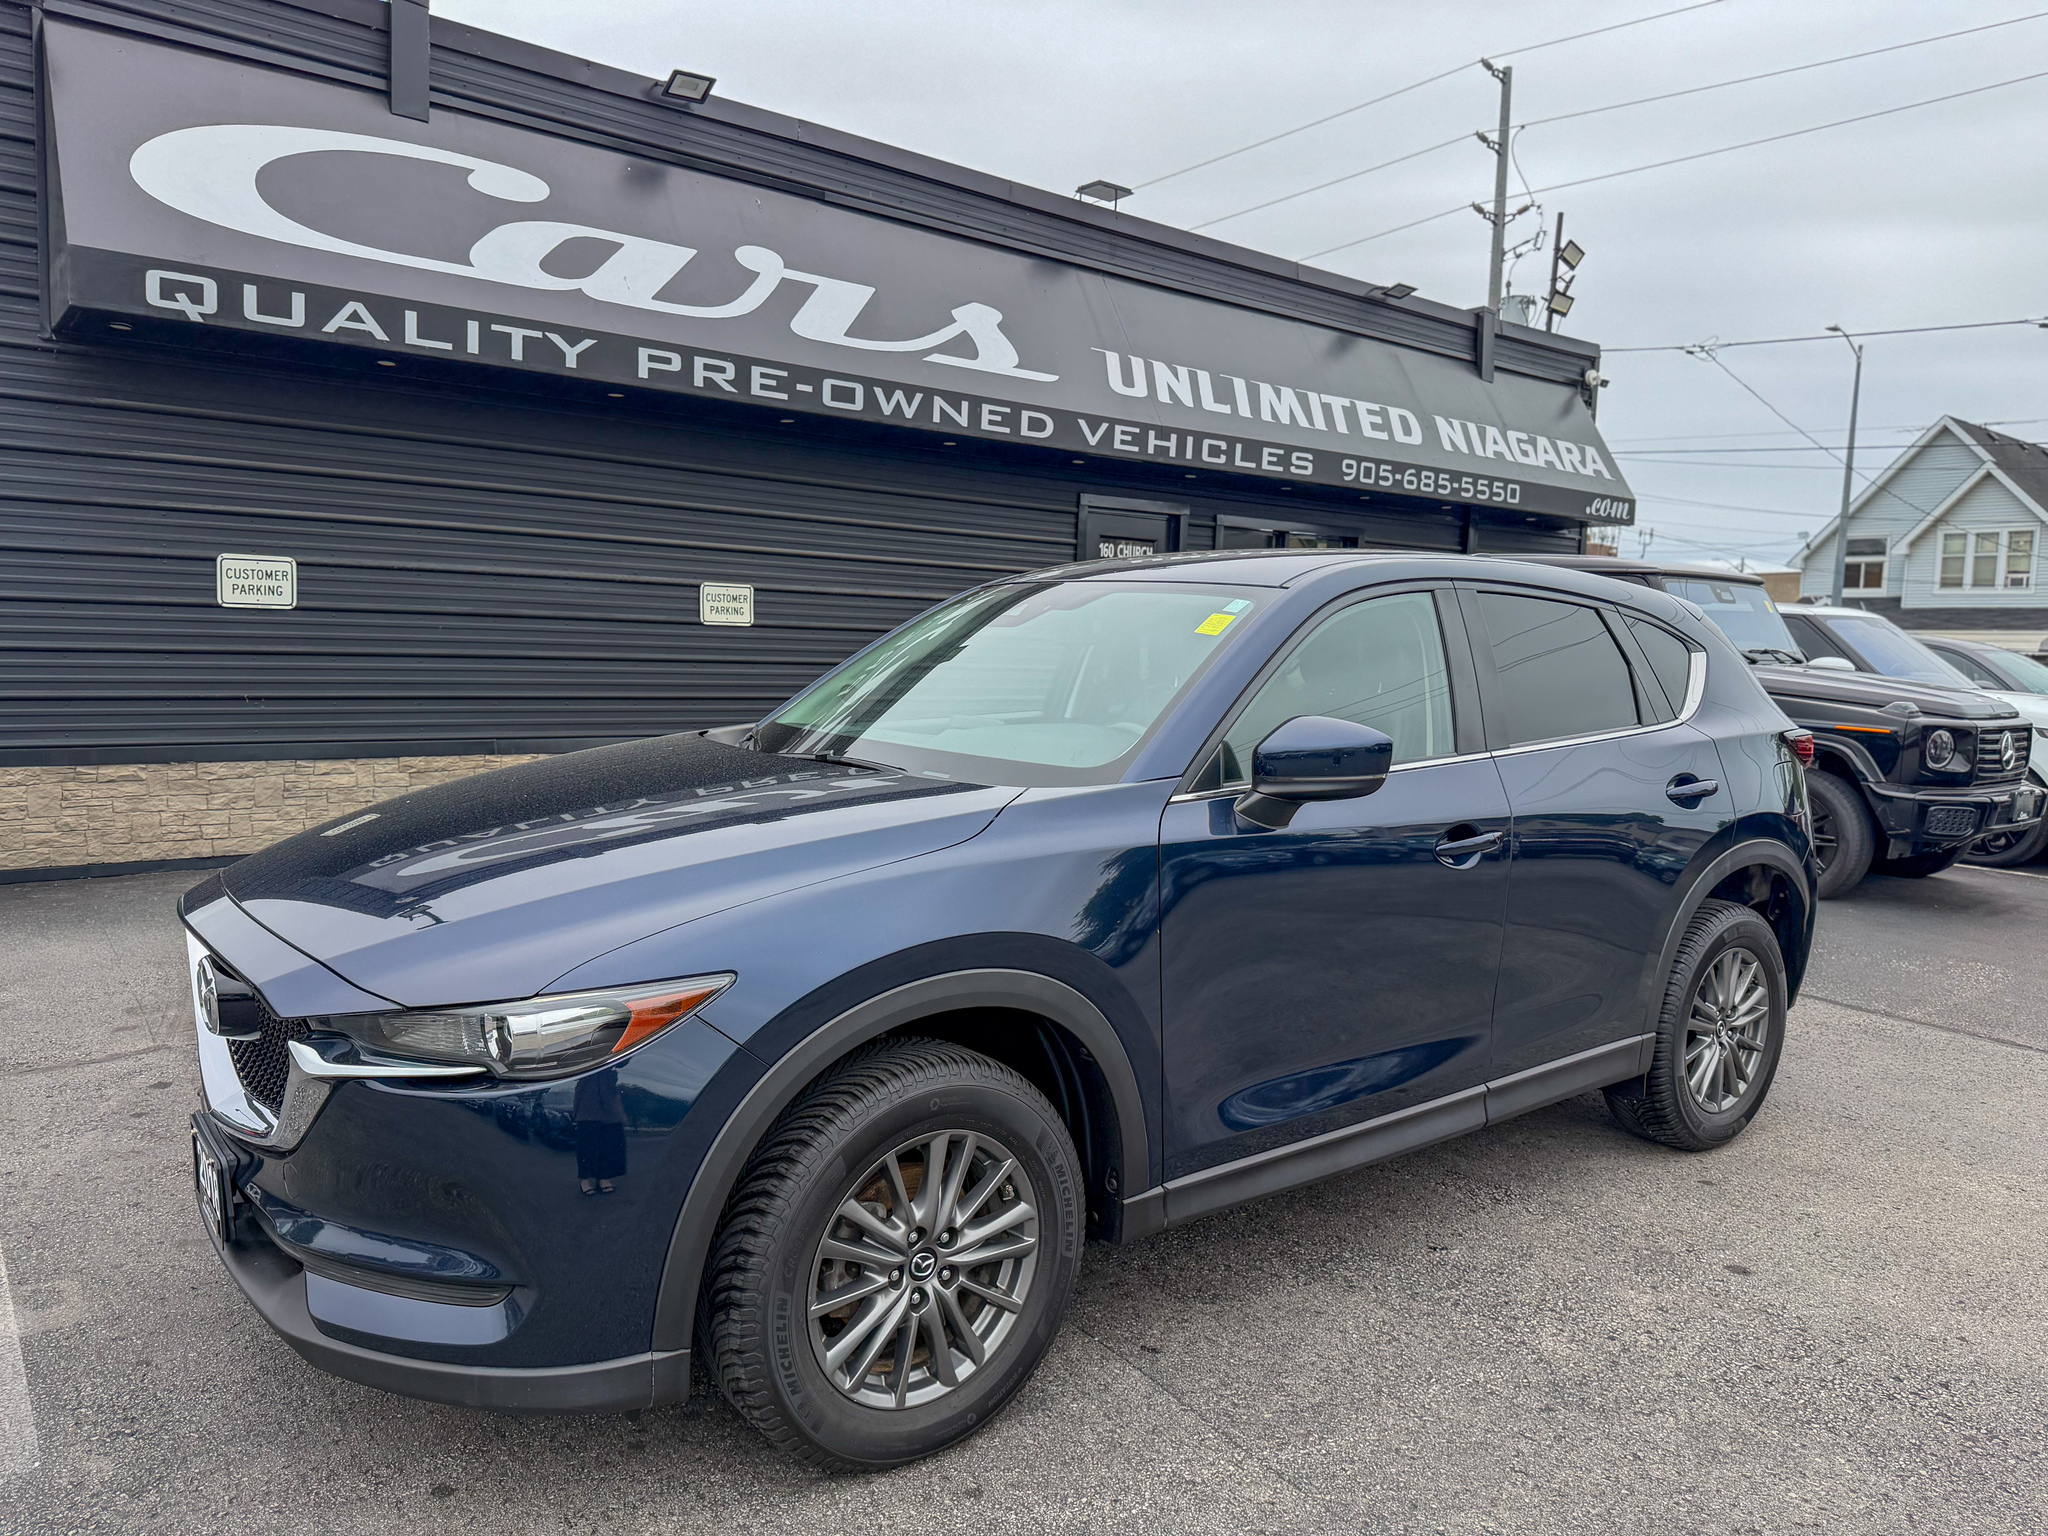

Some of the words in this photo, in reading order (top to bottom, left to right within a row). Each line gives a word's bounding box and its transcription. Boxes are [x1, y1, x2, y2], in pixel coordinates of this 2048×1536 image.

[129, 124, 1059, 382] Cars
[145, 269, 598, 369] QUALITY
[637, 346, 1055, 439] PRE-OWNED
[1077, 418, 1314, 476] VEHICLES
[1340, 458, 1521, 504] 905-685-5550
[1091, 347, 1423, 446] UNLIMITED
[1432, 415, 1613, 481] NIAGARA
[1585, 496, 1631, 521] .com
[1099, 542, 1115, 558] 160
[225, 567, 289, 582] CUSTOMER
[232, 583, 283, 597] PARKING
[705, 592, 748, 604] CUSTOMER
[710, 605, 744, 616] PARKING
[1055, 1163, 1073, 1251] MICHELIN
[776, 1297, 802, 1396] MICHELIN
